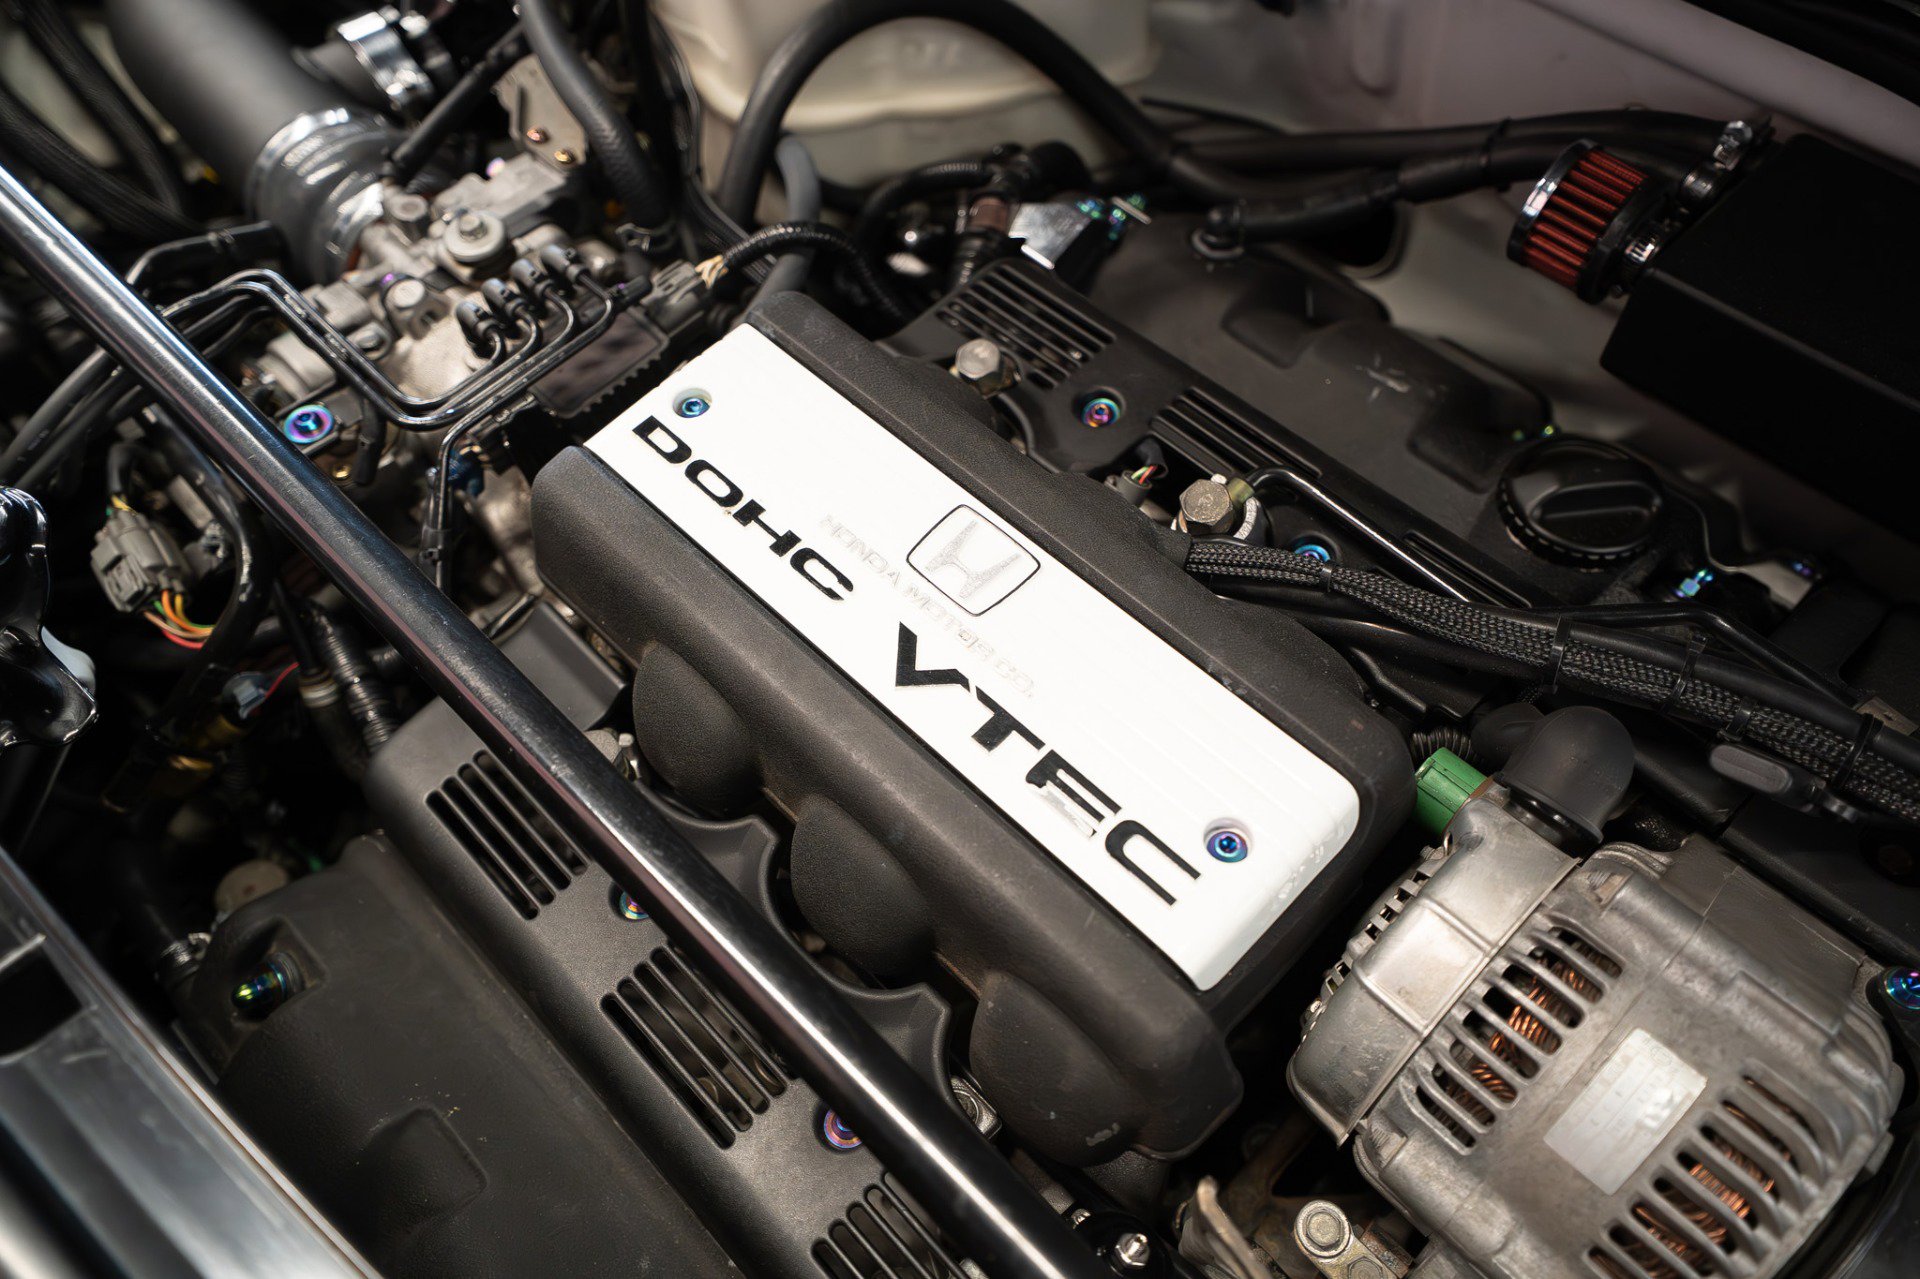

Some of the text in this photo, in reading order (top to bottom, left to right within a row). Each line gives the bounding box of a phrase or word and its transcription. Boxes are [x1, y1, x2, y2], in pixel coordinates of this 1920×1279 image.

[632, 415, 1202, 906] DOHC VTEC
[819, 513, 901, 588] HONDA
[902, 580, 995, 662] MOTOR
